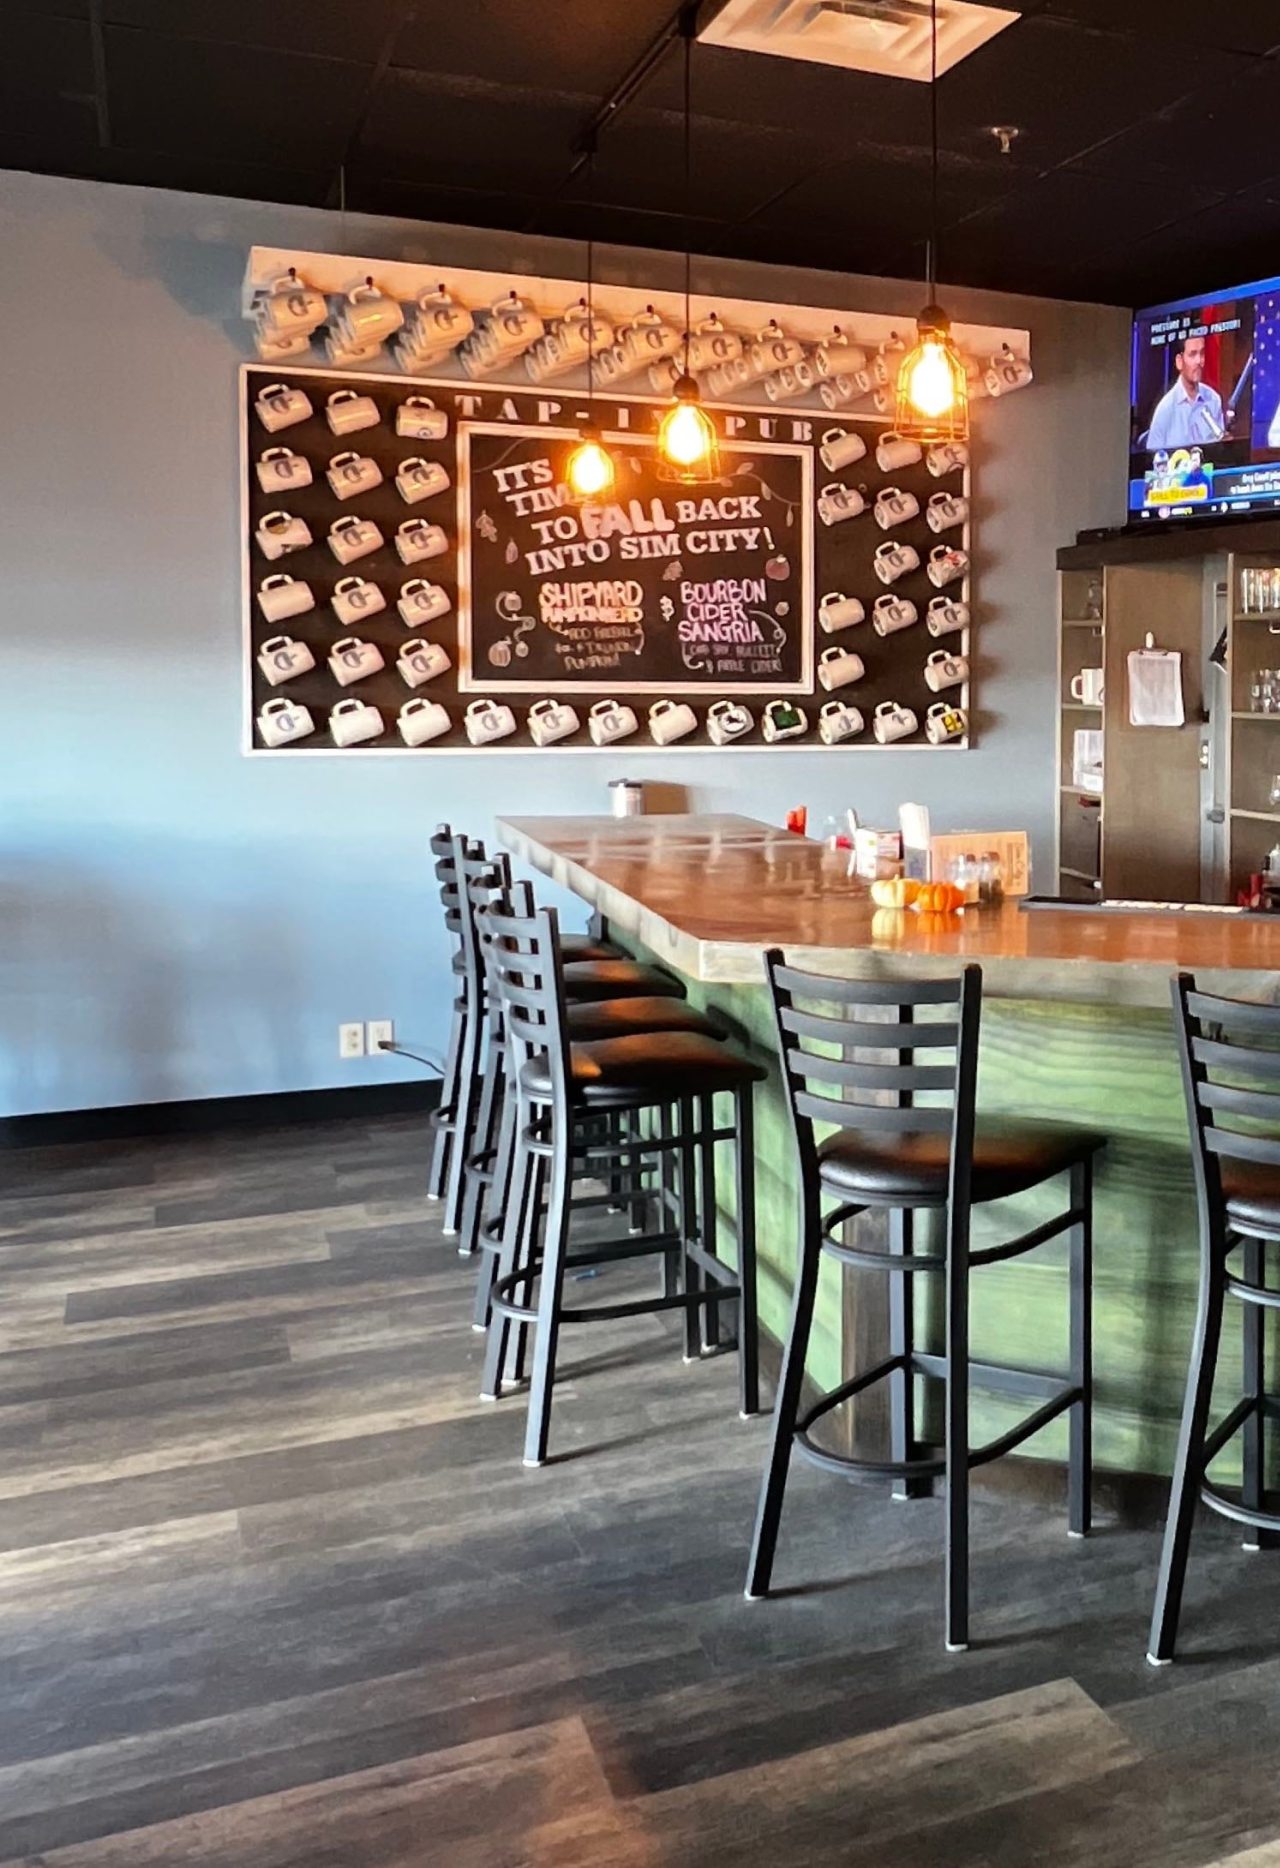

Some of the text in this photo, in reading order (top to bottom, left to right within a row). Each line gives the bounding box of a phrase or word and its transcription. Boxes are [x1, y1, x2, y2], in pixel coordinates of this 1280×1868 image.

[454, 394, 813, 442] TAP-I PUB
[505, 481, 585, 518] TIM
[531, 495, 763, 546] TO FALL BACK
[525, 526, 776, 576] INTO SIM CITY!
[538, 580, 644, 608] SHIPYARD
[680, 578, 767, 605] BOURBON
[686, 601, 749, 622] CIDER
[677, 619, 765, 643] SANGRIA
